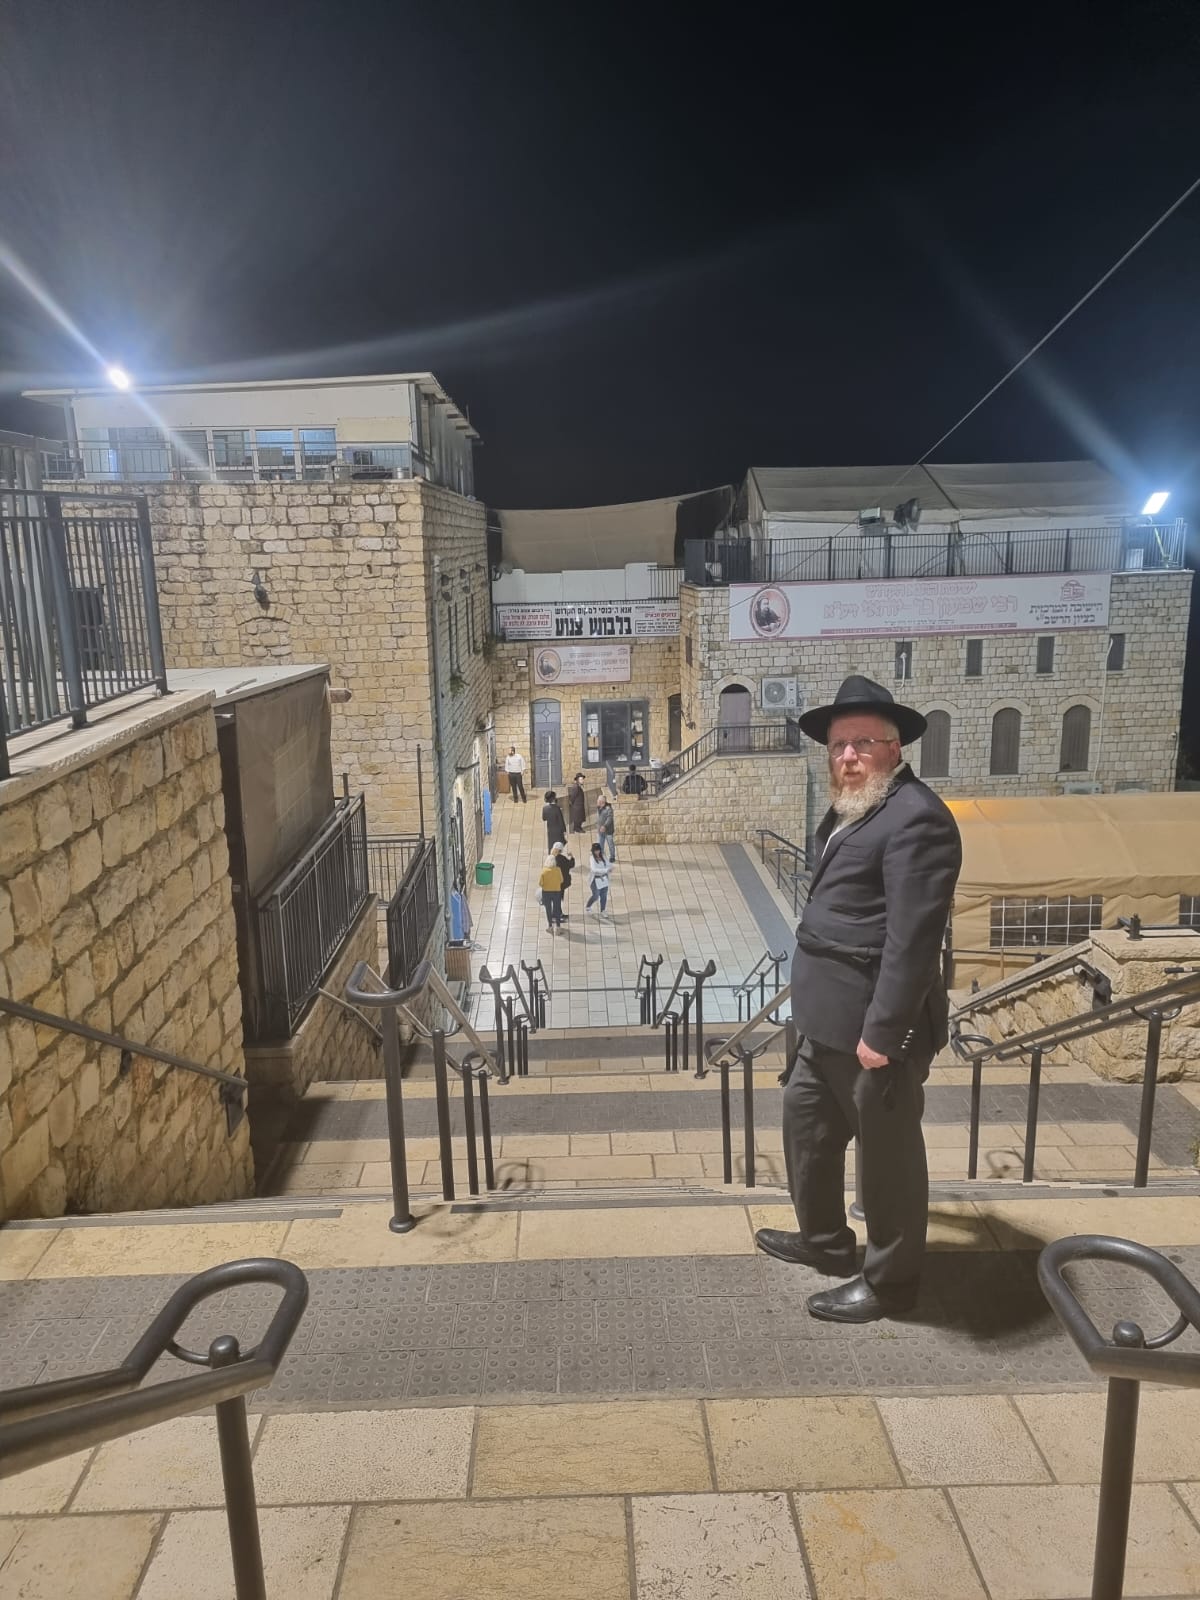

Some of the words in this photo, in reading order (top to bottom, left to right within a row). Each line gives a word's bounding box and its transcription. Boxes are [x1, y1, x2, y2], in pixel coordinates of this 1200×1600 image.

[939, 597, 988, 618] שמעון
[990, 595, 1018, 613] רבי
[1029, 604, 1068, 614] המרכזית
[1070, 602, 1103, 612] הישיבה
[555, 607, 576, 616] הקדוש
[577, 606, 597, 615] למקום
[620, 606, 632, 614] אנא
[1074, 614, 1096, 625] בציון
[555, 617, 584, 637] צנוע
[589, 616, 632, 636] בלבוש
